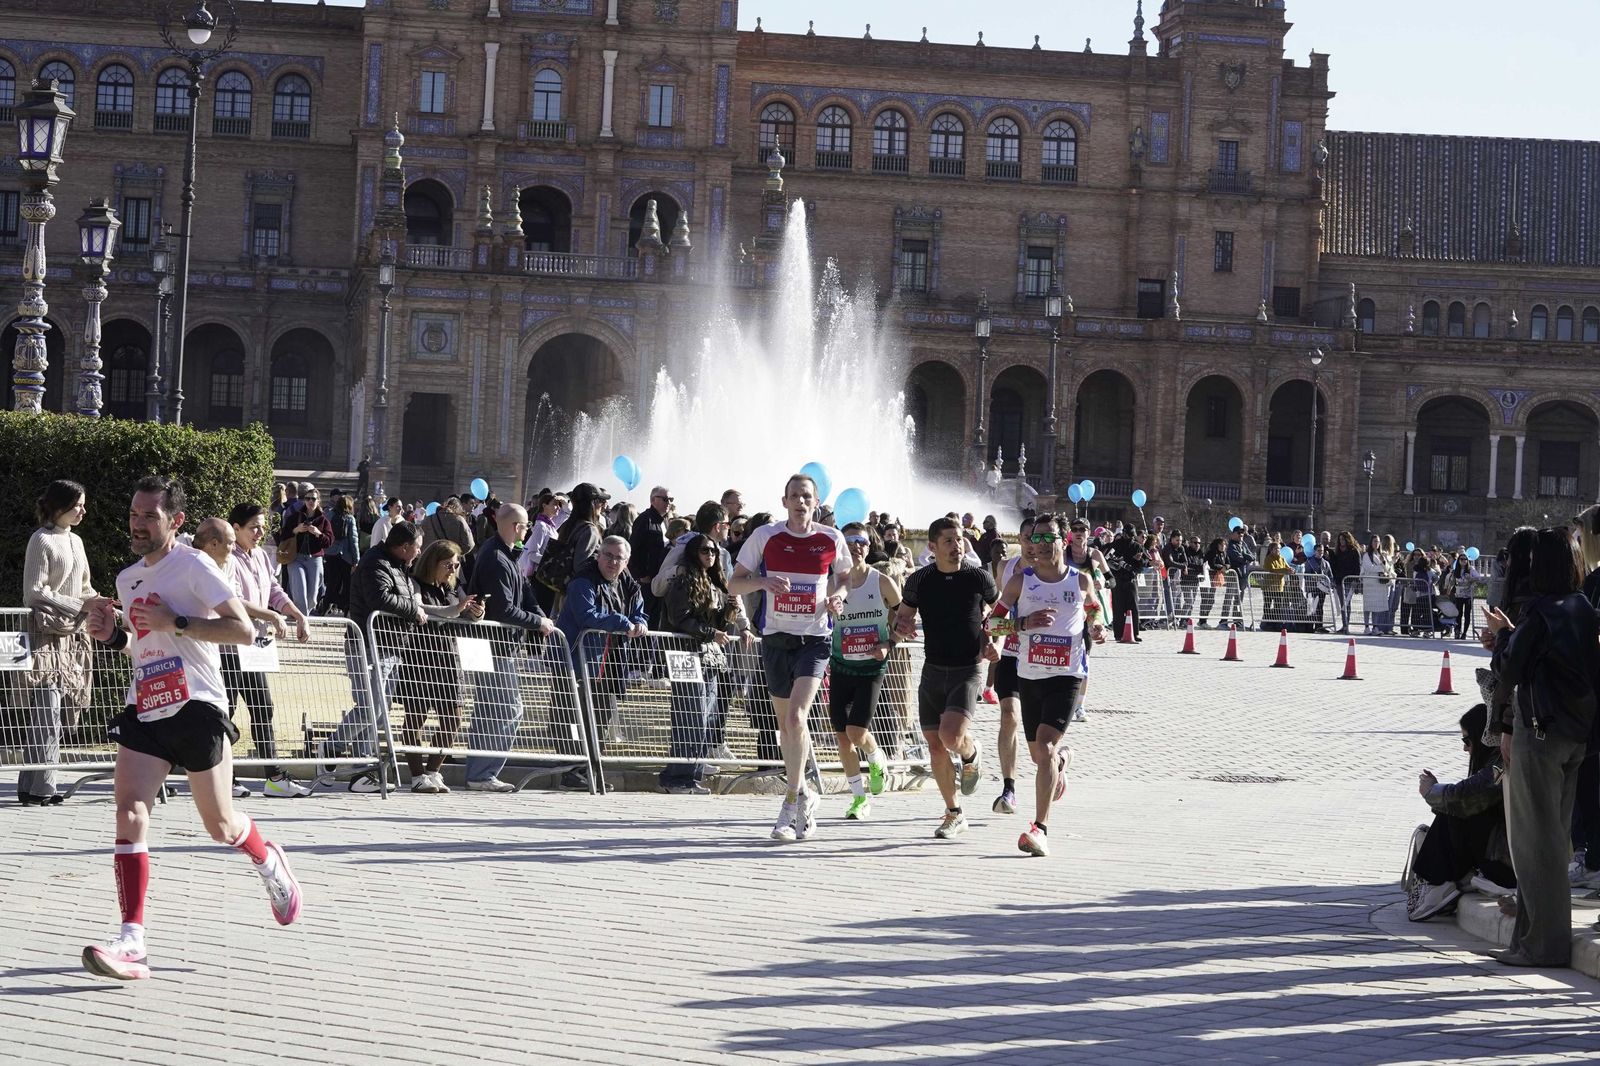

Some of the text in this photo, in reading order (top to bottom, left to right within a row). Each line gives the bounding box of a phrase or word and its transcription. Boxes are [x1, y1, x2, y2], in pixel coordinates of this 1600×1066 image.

[777, 603, 812, 613] PHILIPPE
[1032, 655, 1066, 665] MARIO P.
[146, 660, 176, 675] ZURICH
[174, 688, 182, 700] 5
